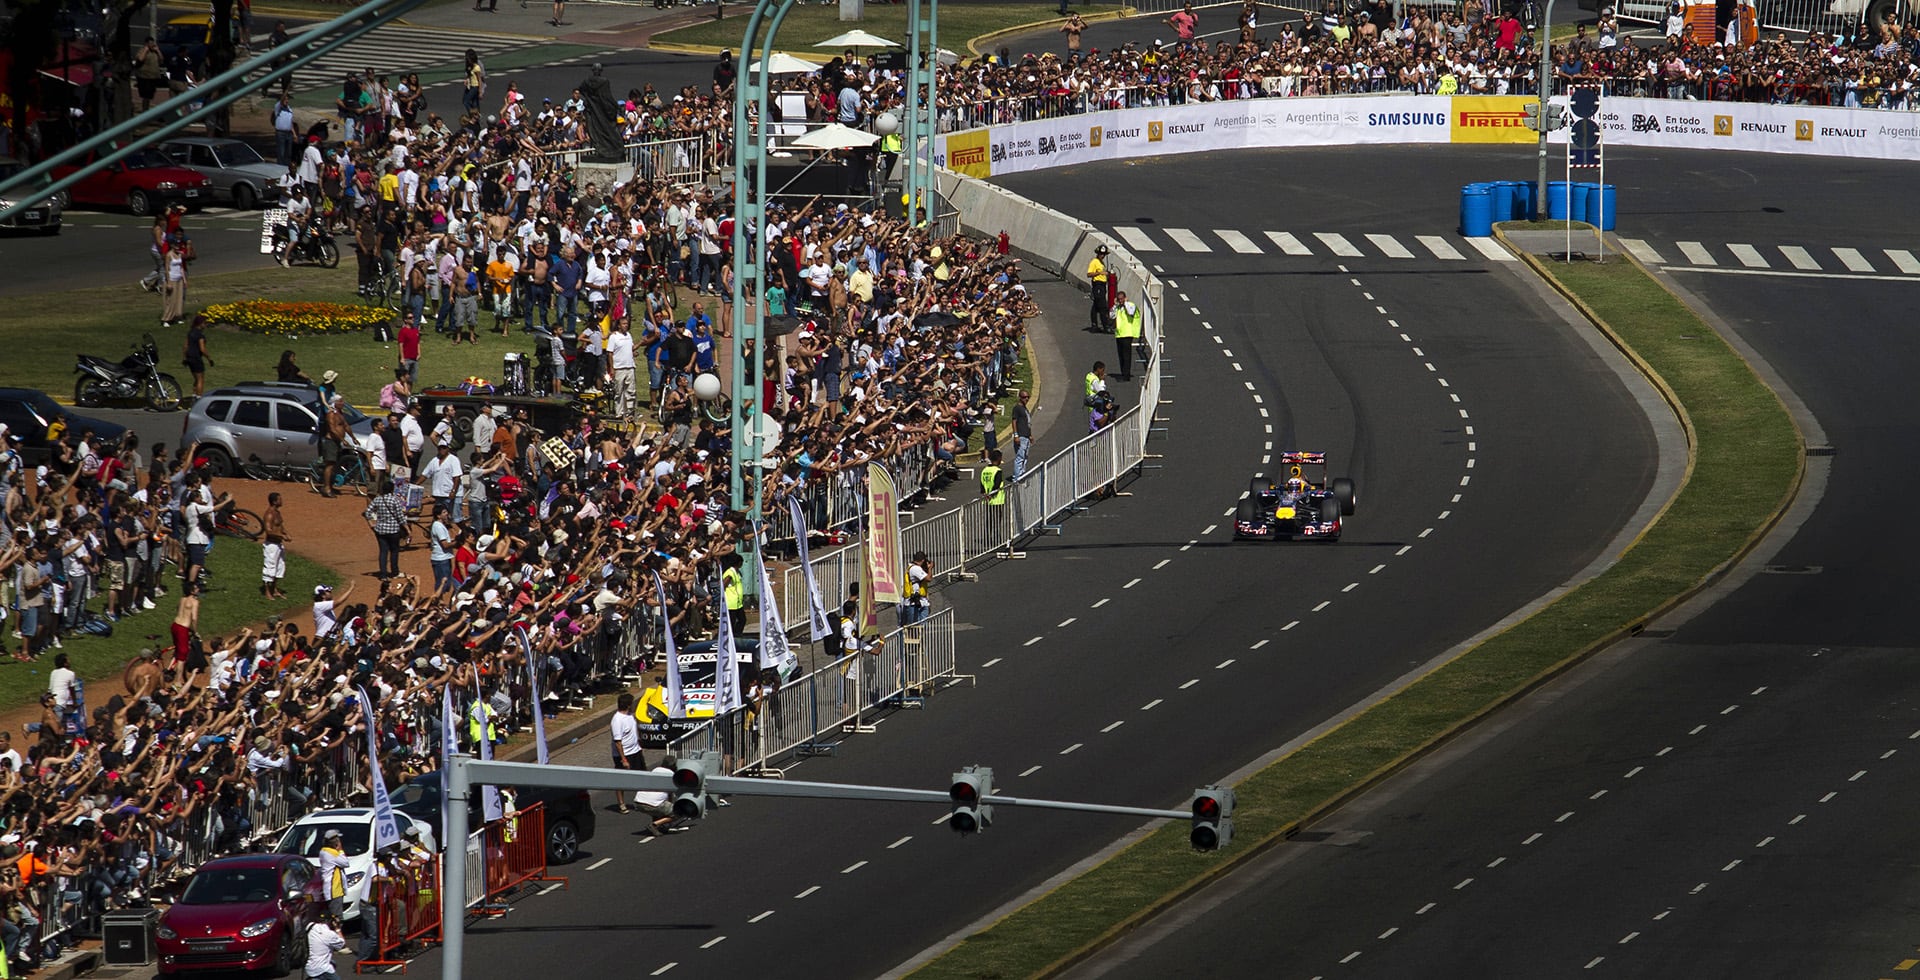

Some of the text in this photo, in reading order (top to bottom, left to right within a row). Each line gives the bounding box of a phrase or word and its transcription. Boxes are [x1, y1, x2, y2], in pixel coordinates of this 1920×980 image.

[1213, 114, 1256, 129] Argentina
[1286, 112, 1339, 125] Argentina
[1368, 112, 1446, 126] SAMSUNG
[1460, 112, 1529, 128] PIRELL
[1665, 116, 1701, 125] En todo
[1169, 123, 1205, 134] RENAULT
[1665, 124, 1708, 135] estás vos.
[1741, 122, 1787, 133] RENAULT
[1821, 127, 1867, 138] RENAULT
[1879, 125, 1920, 139] Argenti
[1059, 132, 1082, 142] En todo
[1106, 128, 1141, 139] RENAULT
[1009, 139, 1031, 150] En todo
[1059, 142, 1075, 151] estás
[1076, 141, 1087, 150] vos.
[952, 146, 985, 167] PIRELLI
[1009, 148, 1036, 159] estás vos.
